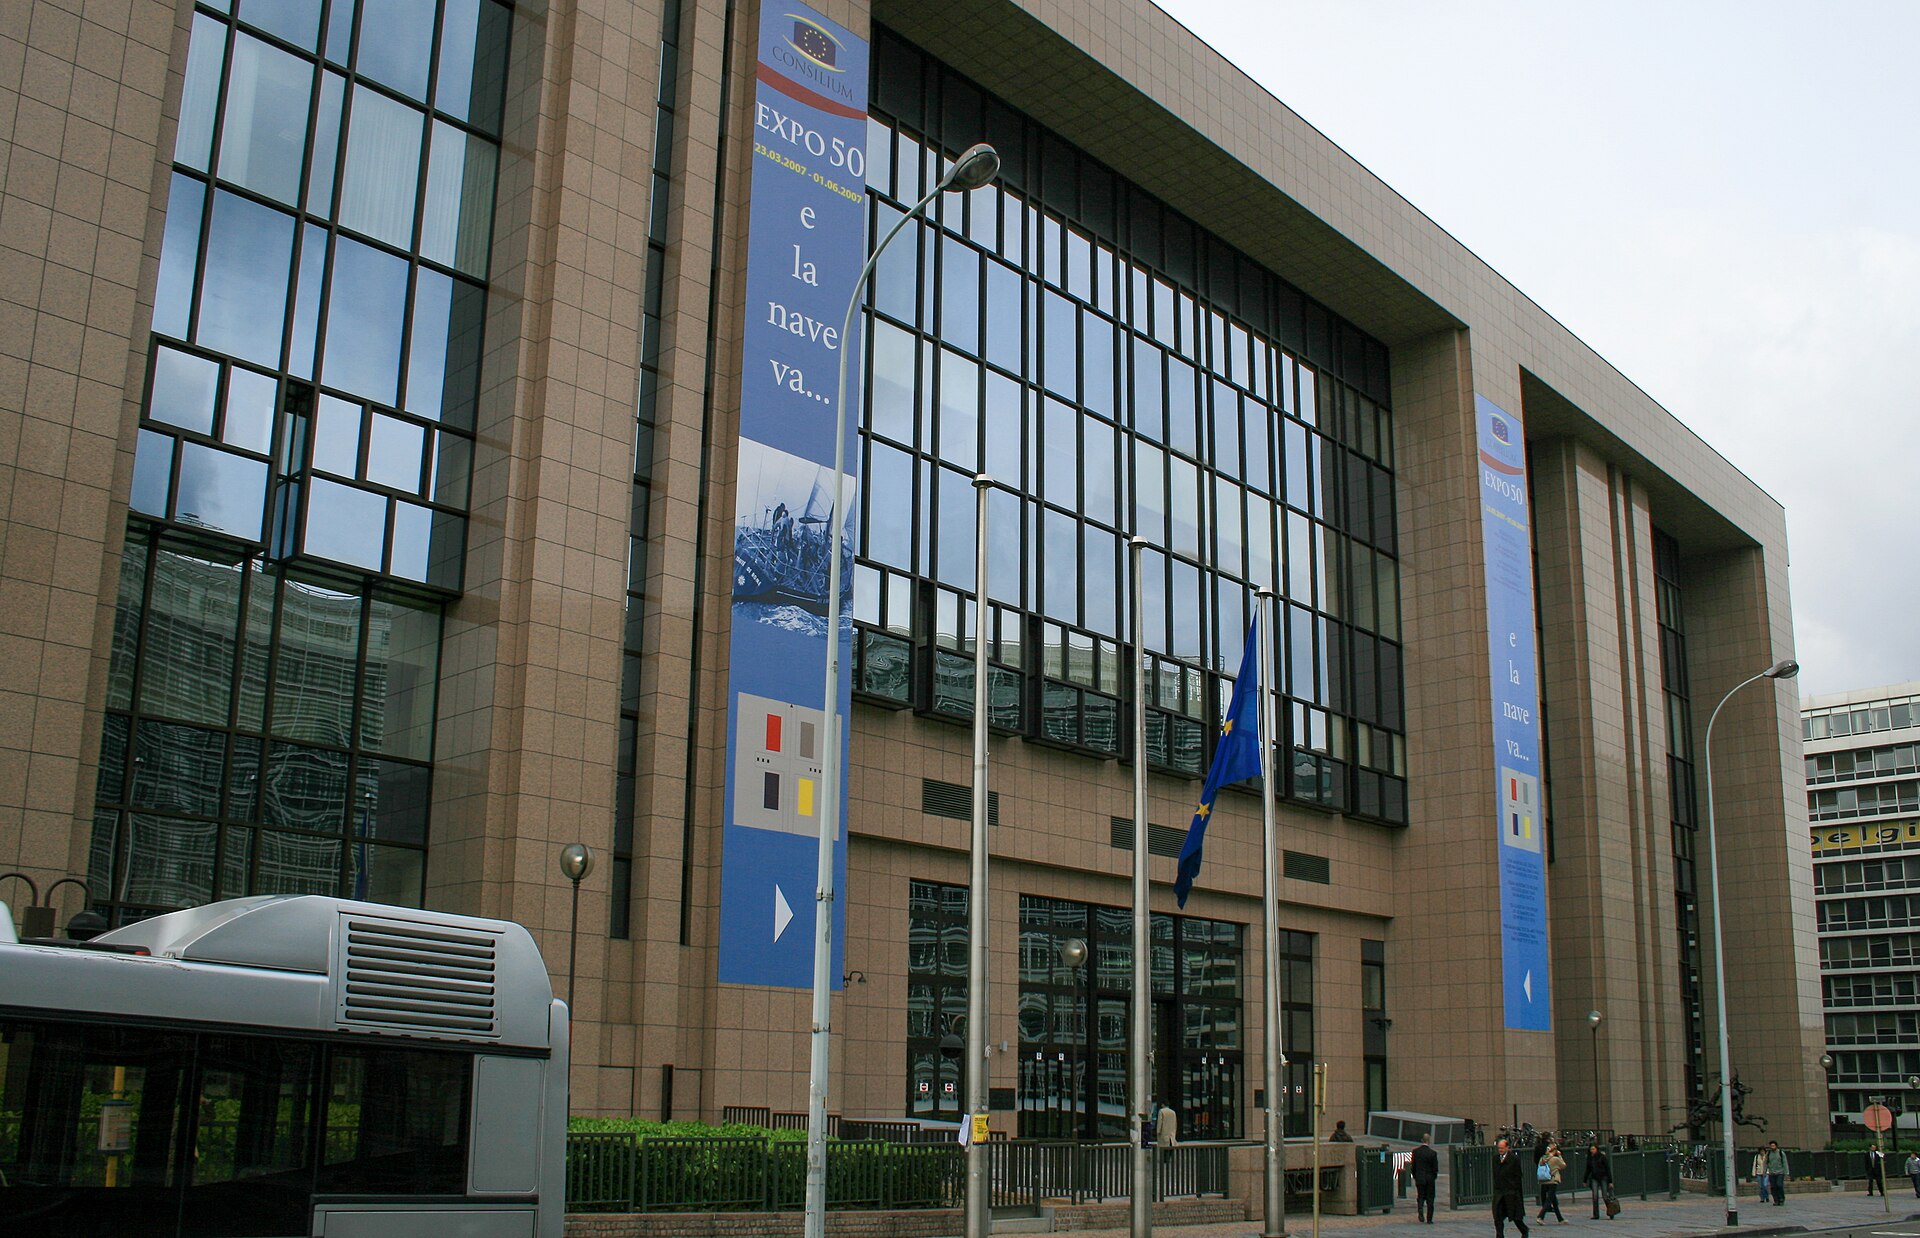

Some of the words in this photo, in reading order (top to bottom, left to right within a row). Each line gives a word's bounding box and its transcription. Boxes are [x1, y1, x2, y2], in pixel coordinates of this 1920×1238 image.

[772, 46, 853, 102] CONSILIUM
[756, 101, 825, 157] EXPO
[829, 137, 865, 178] 50
[755, 142, 806, 176] 23.03.2007
[813, 172, 863, 204] 01.06.2007
[800, 205, 816, 230] e
[792, 244, 818, 287] la
[767, 301, 838, 350] nave
[769, 359, 830, 405] va...
[1485, 470, 1510, 498] EXPO
[1510, 484, 1523, 505] 50
[1509, 632, 1516, 648] e
[1509, 659, 1520, 686] la
[1503, 701, 1530, 725] nave
[1506, 739, 1529, 761] va...
